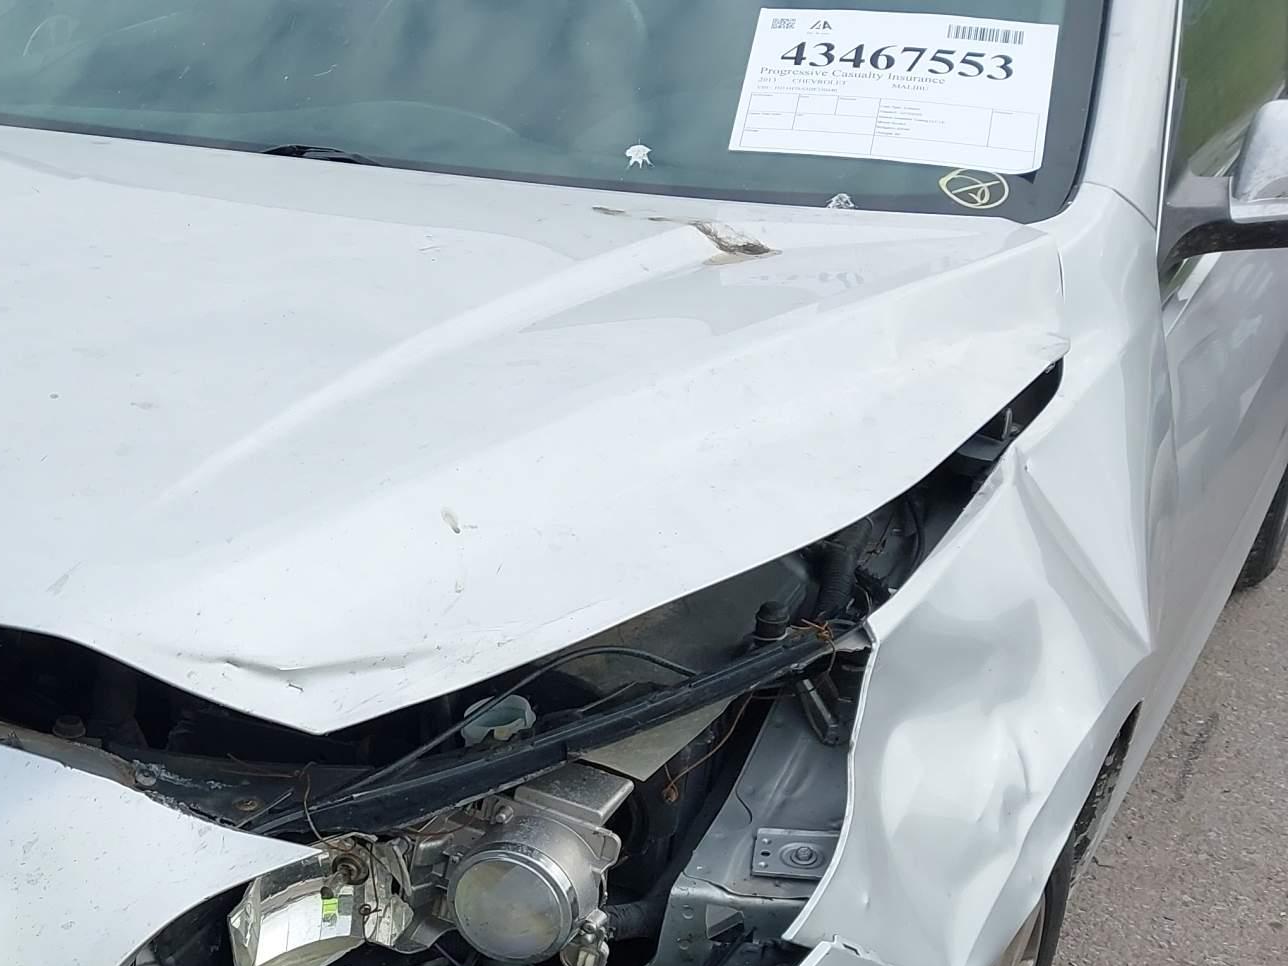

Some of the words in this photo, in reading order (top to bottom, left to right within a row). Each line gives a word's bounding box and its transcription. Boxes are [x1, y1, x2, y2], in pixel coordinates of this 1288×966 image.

[759, 66, 829, 78] Progressive
[831, 69, 884, 81] Casualty
[887, 72, 946, 85] Insurance
[780, 40, 1015, 82] 43467553
